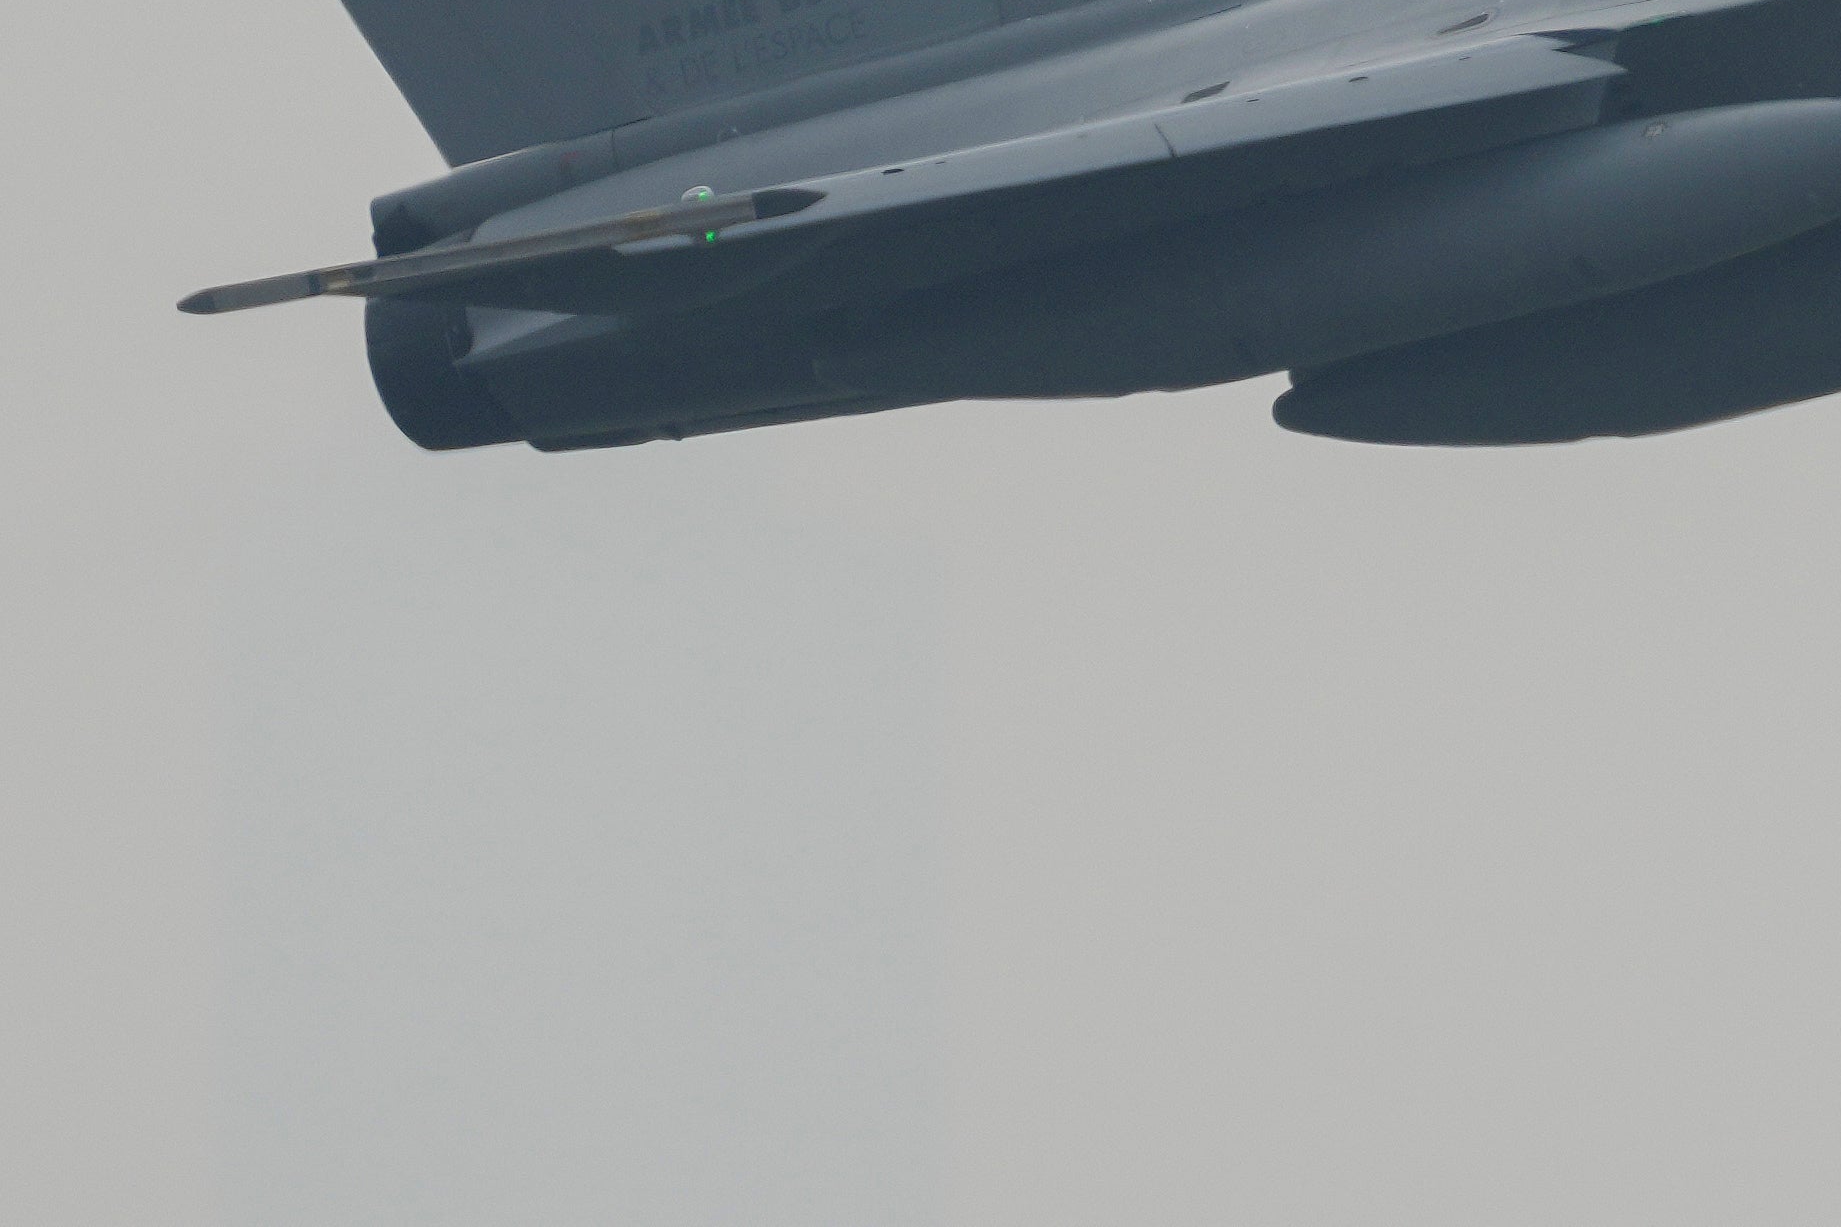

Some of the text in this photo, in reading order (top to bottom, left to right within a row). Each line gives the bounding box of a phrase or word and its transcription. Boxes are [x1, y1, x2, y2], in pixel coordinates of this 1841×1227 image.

[645, 9, 869, 96] & DE L'ESPACE
